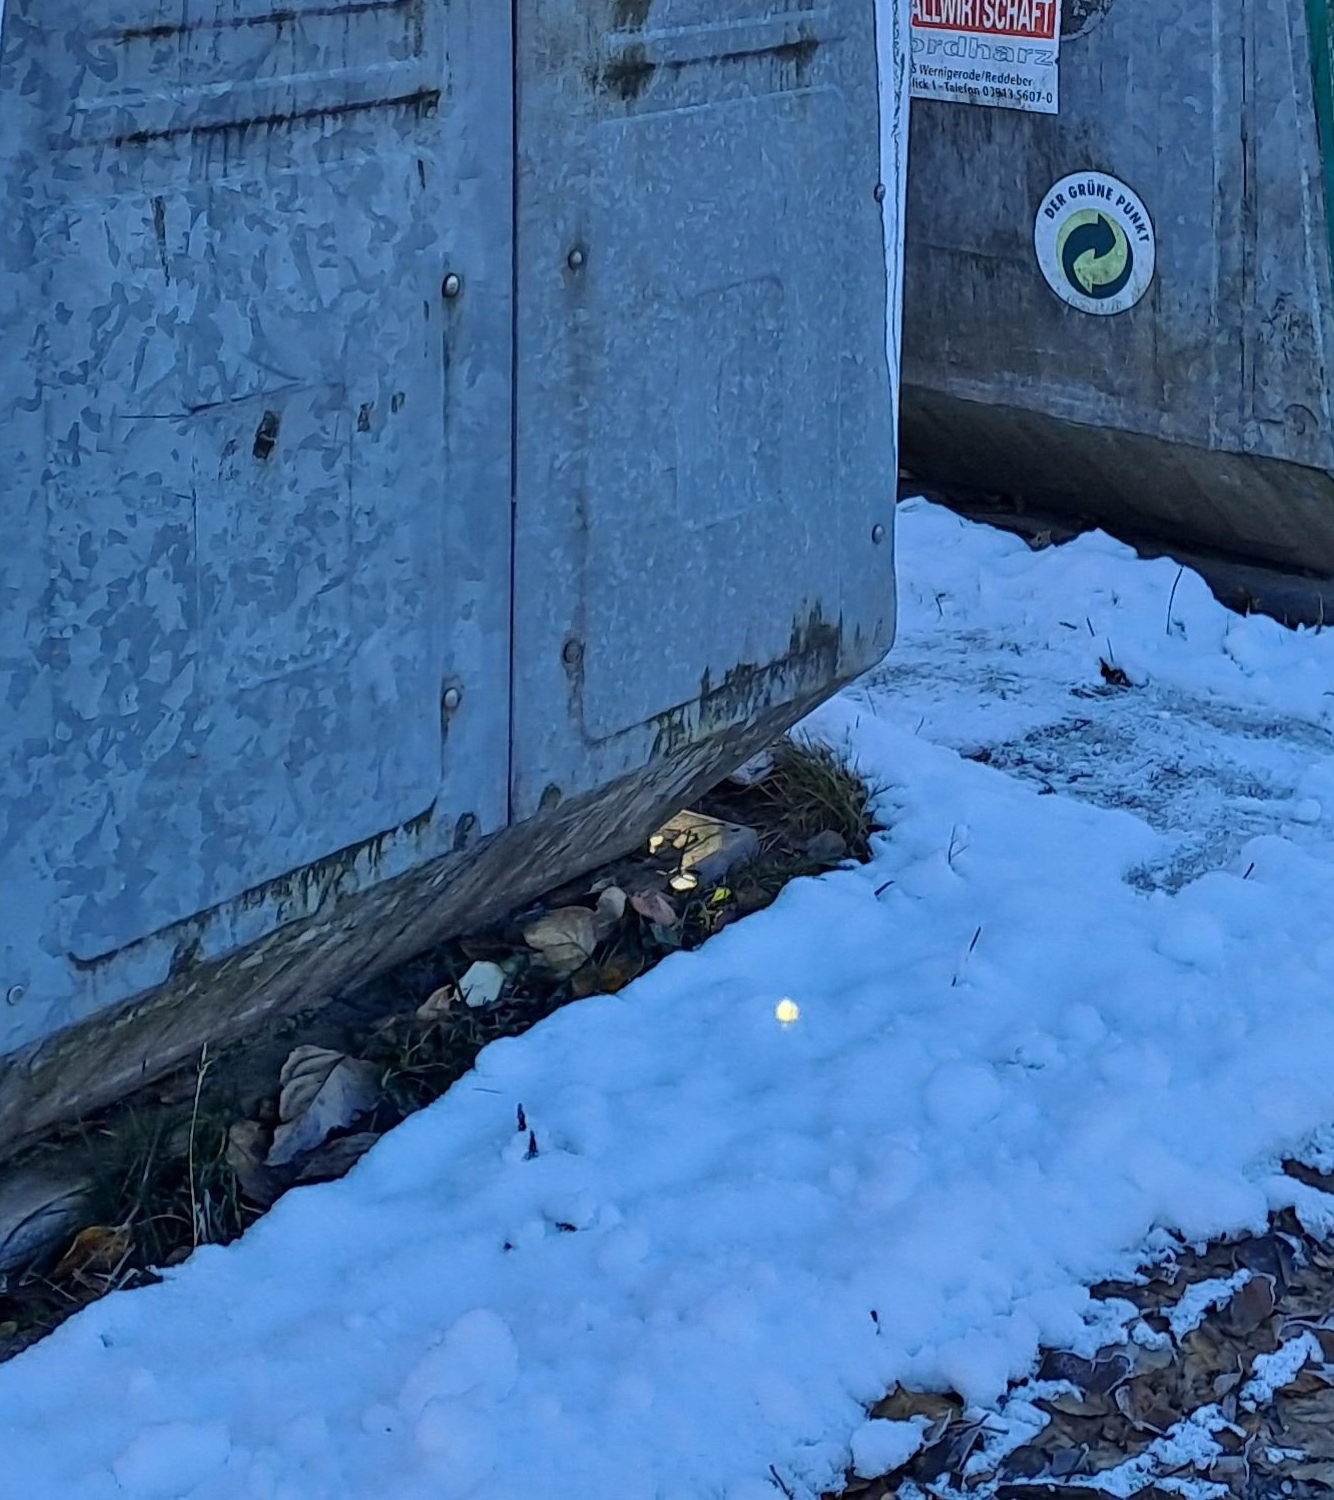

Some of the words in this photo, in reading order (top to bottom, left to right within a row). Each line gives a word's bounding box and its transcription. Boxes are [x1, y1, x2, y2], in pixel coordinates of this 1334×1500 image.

[910, 36, 1055, 67] ordharz
[912, 78, 929, 89] lick
[919, 64, 1034, 87] Wernigerode/Reddeber
[1044, 193, 1067, 220] DER
[1068, 179, 1114, 201] GRÜNE
[1115, 194, 1150, 242] PUNKT
